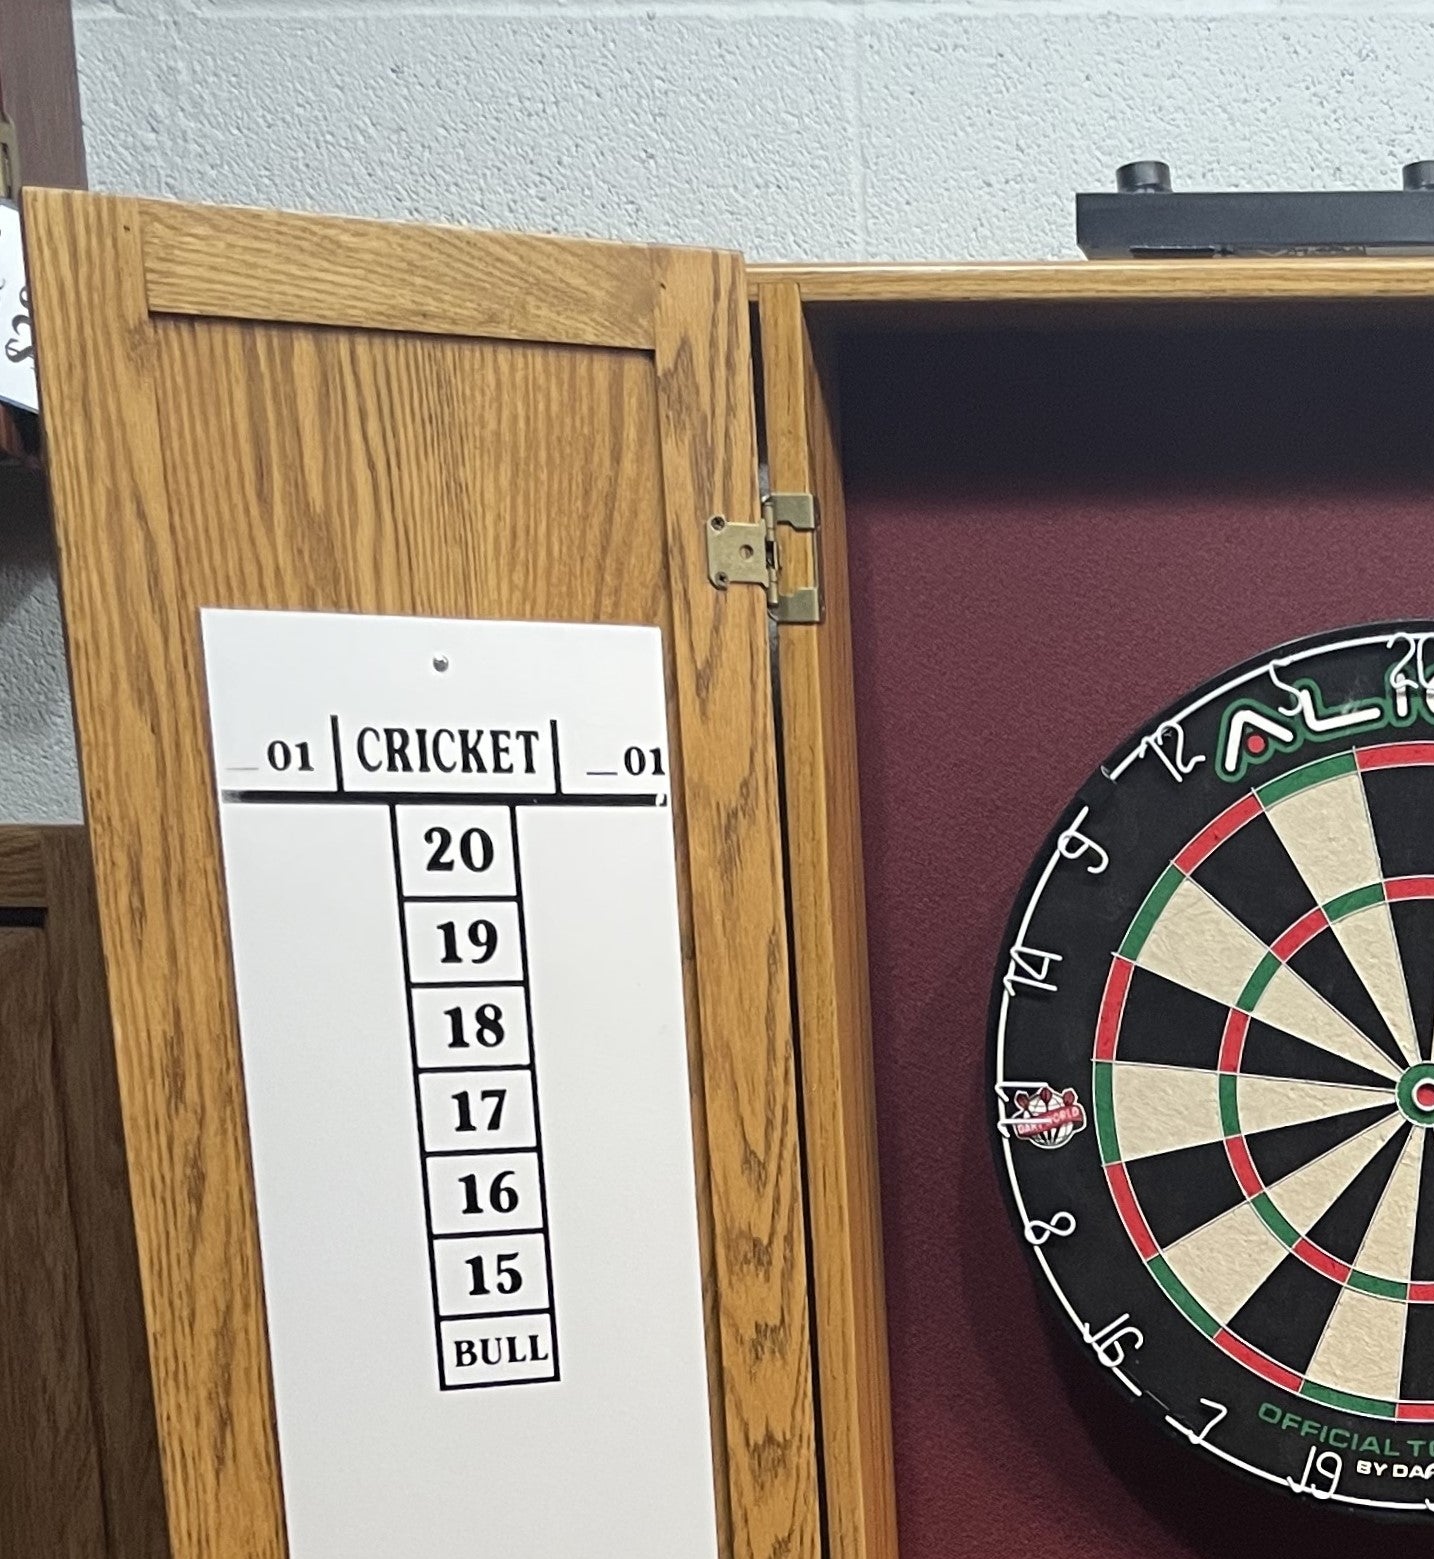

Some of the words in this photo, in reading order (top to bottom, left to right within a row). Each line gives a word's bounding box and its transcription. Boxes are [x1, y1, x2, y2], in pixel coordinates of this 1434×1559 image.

[1269, 660, 1302, 716] 5
[357, 727, 540, 774] CRICKET
[1138, 721, 1206, 782] 12
[424, 826, 494, 873] 20
[1058, 829, 1109, 874] 9
[436, 919, 498, 964] 19
[1004, 946, 1063, 996] 14
[444, 1003, 505, 1049] 18
[451, 1089, 507, 1132] 17
[995, 1081, 1052, 1138] 11
[458, 1170, 519, 1215] 16
[1024, 1212, 1076, 1245] 8
[465, 1252, 523, 1296] 15
[454, 1334, 549, 1368] BULL
[1083, 1313, 1144, 1367] 16
[1189, 1398, 1228, 1444] 7
[1257, 1402, 1400, 1456] OFFICIAL
[1287, 1445, 1342, 1499] 19
[1356, 1460, 1388, 1477] BY
